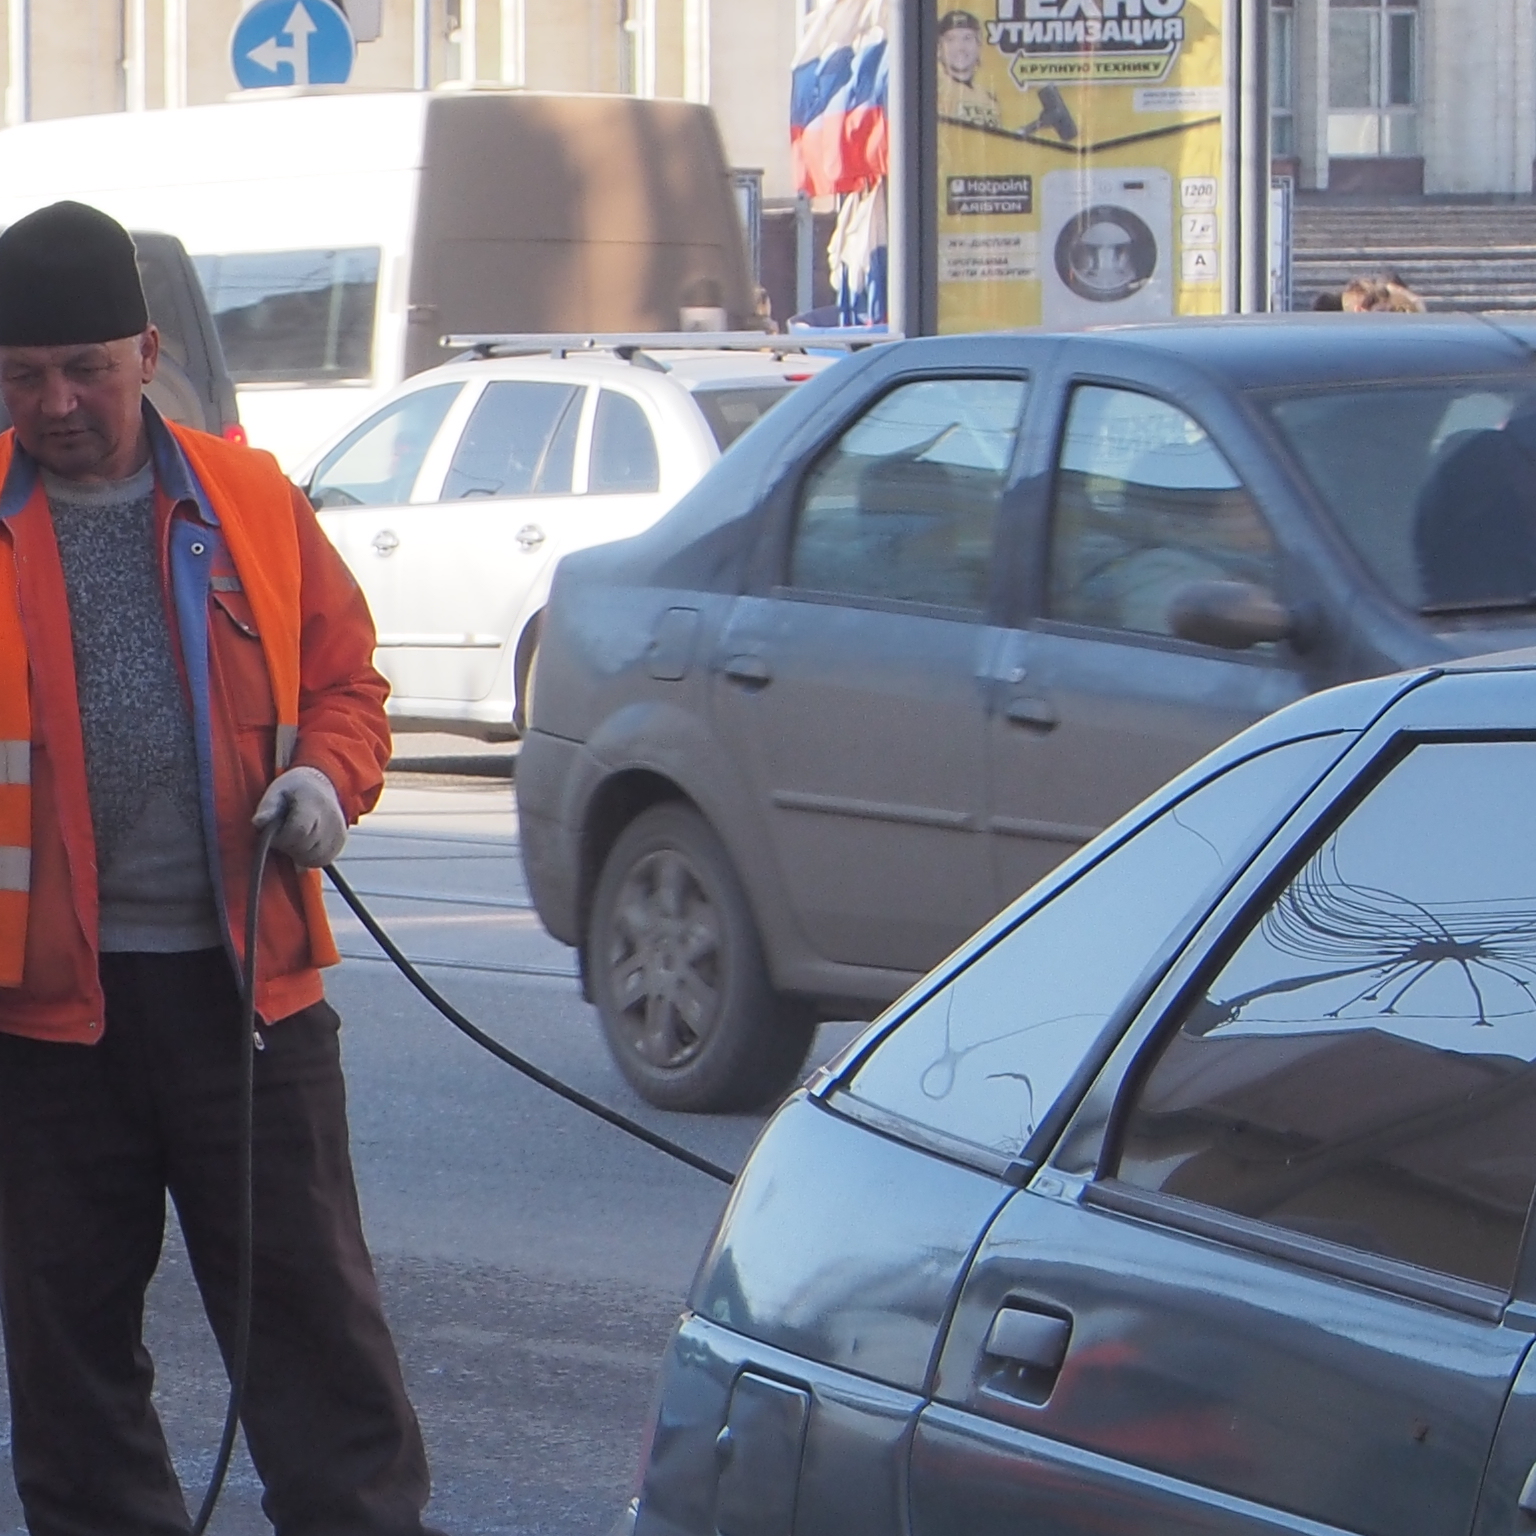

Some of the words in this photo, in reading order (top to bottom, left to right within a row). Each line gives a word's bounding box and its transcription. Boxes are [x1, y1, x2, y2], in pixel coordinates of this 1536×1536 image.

[987, 19, 1184, 45] УТИЛИЗАЦИЯ
[1019, 62, 1091, 74] КРУПНУЮ
[1093, 61, 1161, 73] ТЕХНИКУ
[968, 179, 1029, 194] Hotpoint
[1184, 184, 1214, 197] 1200
[960, 201, 1022, 213] ARISTON
[1189, 219, 1198, 232] 7
